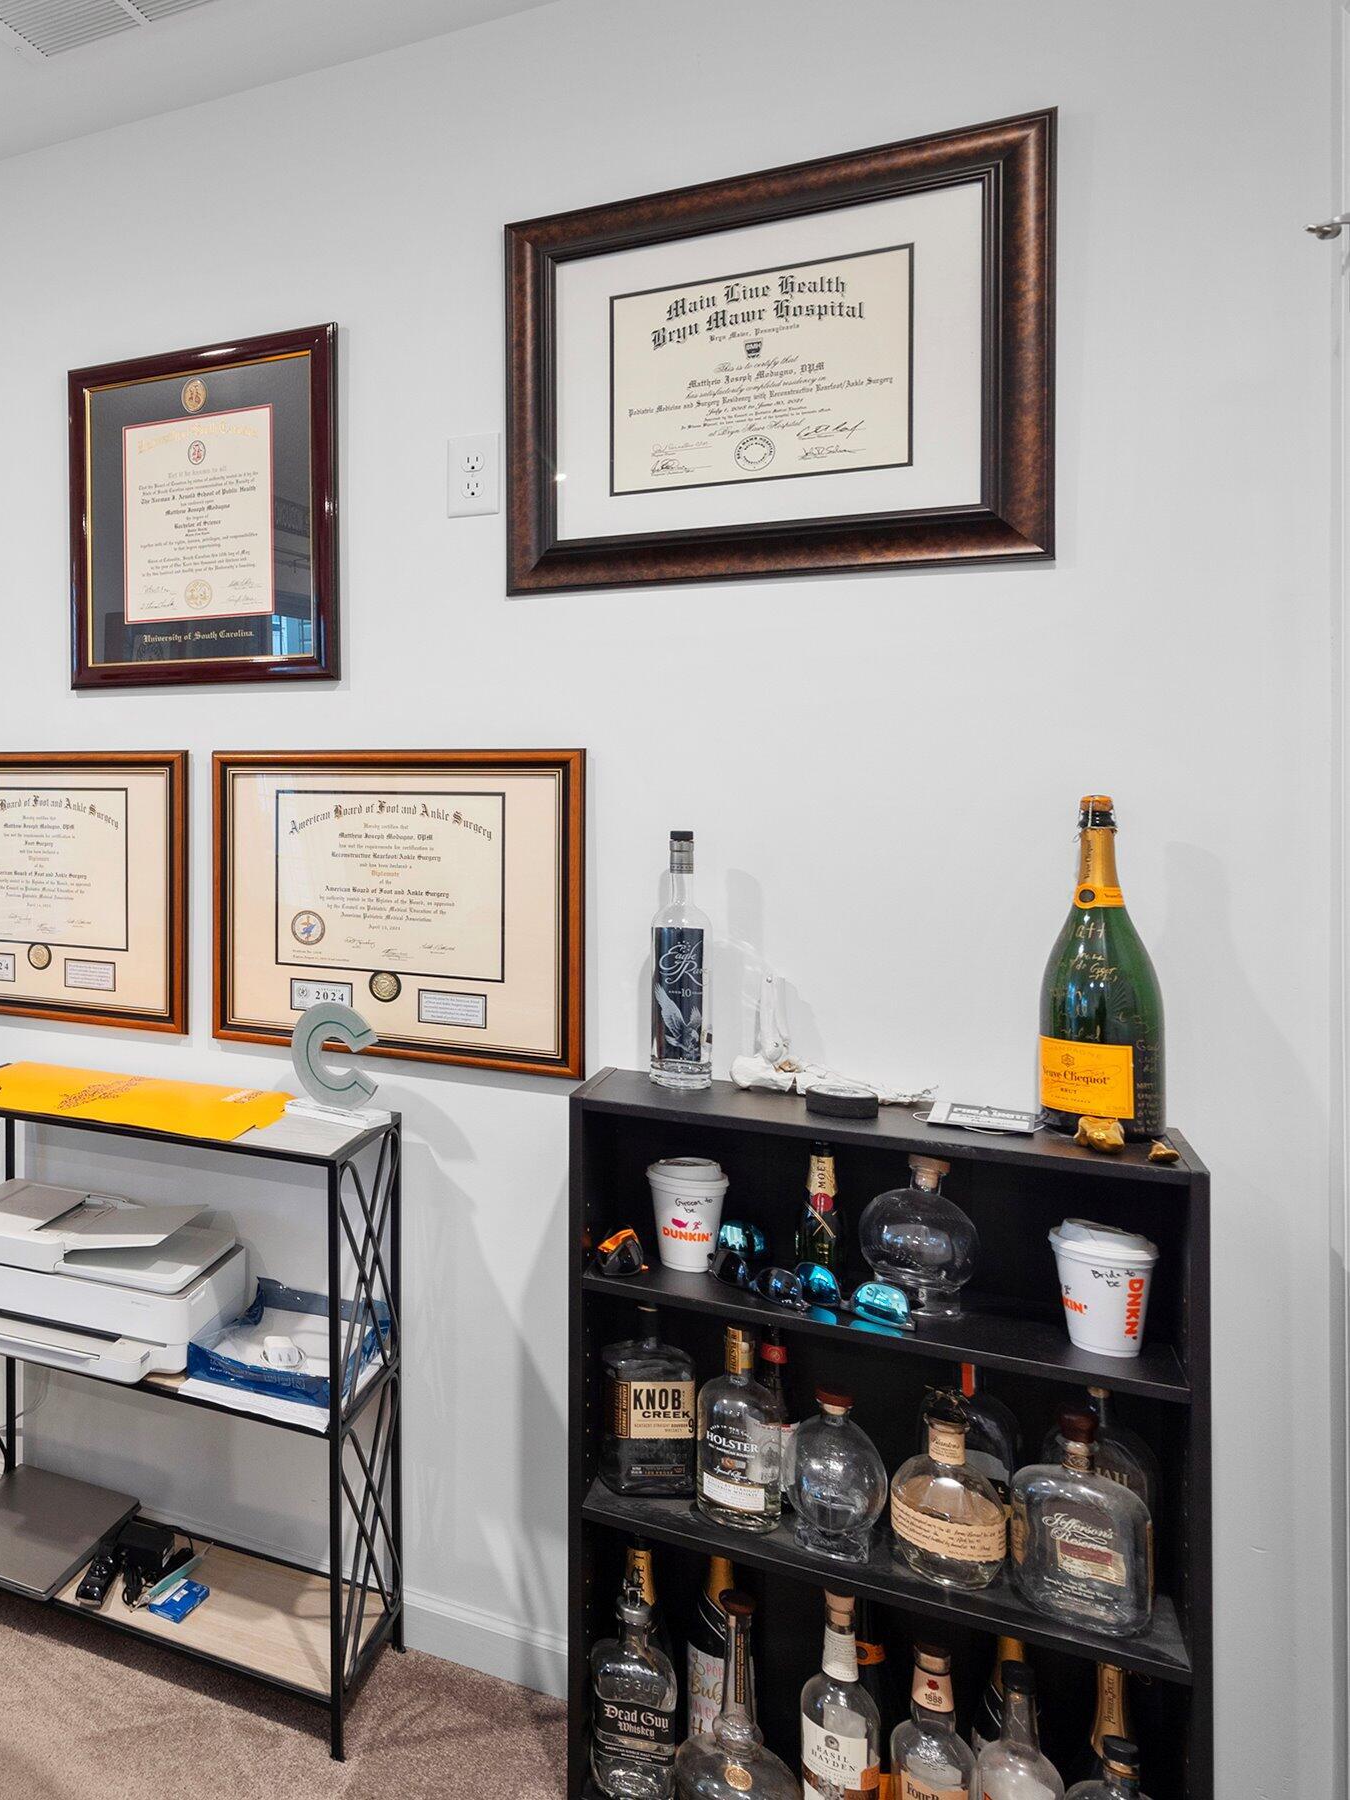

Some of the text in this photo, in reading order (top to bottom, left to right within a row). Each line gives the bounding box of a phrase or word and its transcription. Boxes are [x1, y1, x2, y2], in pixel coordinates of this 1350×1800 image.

[666, 275, 846, 320] Main Line Health
[651, 299, 865, 350] Bryn Mawr Hospital
[687, 379, 720, 388] Matthew
[725, 373, 751, 384] Joseph
[143, 633, 182, 644] University
[184, 631, 191, 641] of
[193, 630, 217, 641] South
[0, 798, 22, 812] Board
[24, 798, 31, 808] of
[33, 795, 50, 807] Foot
[51, 799, 63, 809] and
[64, 798, 87, 814] Ankle
[89, 804, 120, 831] Surgery
[288, 800, 492, 842] American Board of Foot and Ankle Surgery
[659, 944, 697, 973] Eagle
[315, 990, 345, 1003] 2024
[681, 988, 692, 998] 10
[1064, 1070, 1107, 1085] Clicquot
[662, 1226, 713, 1242] DUNKIN'
[1091, 1269, 1121, 1279] Bride
[632, 1388, 681, 1410] KNOB
[641, 1411, 691, 1419] CREEK
[687, 1418, 694, 1434] 9
[706, 1430, 759, 1453] HOLSTER
[1042, 1513, 1113, 1539] Jefferson's
[925, 1693, 943, 1705] 1888
[603, 1703, 669, 1732] Dead Guy
[617, 1721, 655, 1740] Whiskey
[811, 1749, 856, 1772] HAYDEN
[816, 1745, 848, 1763] BASIL
